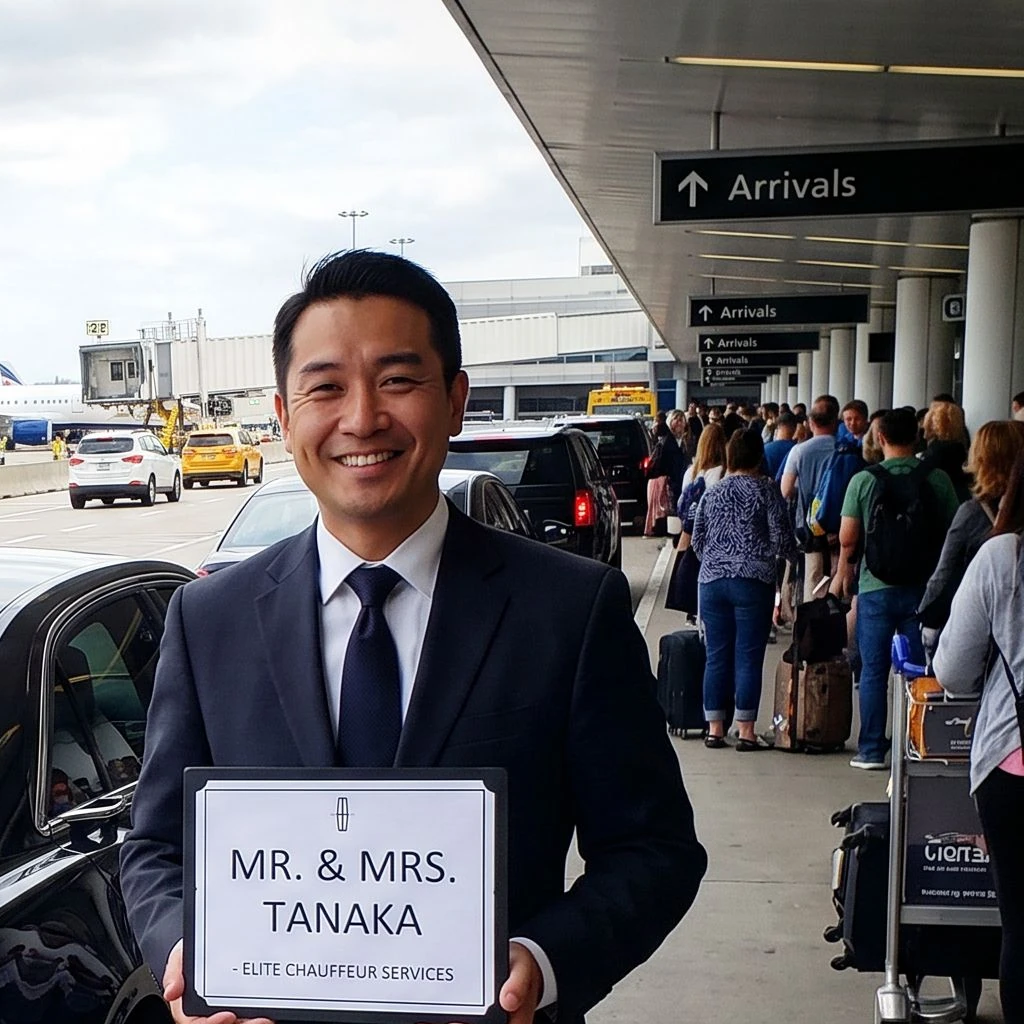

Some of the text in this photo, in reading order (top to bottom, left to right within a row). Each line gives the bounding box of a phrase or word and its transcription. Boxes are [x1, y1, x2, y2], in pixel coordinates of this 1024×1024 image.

[728, 168, 856, 201] Arrivals
[720, 304, 777, 319] Arrivals
[717, 337, 758, 348] Arrivals
[716, 356, 749, 364] Arrivals
[231, 849, 456, 883] MR. & MRS.
[262, 901, 423, 936] TANAKA
[242, 963, 281, 977] ELITE
[285, 964, 378, 979] CHAUFFEUR
[381, 966, 454, 982] SERVICES
